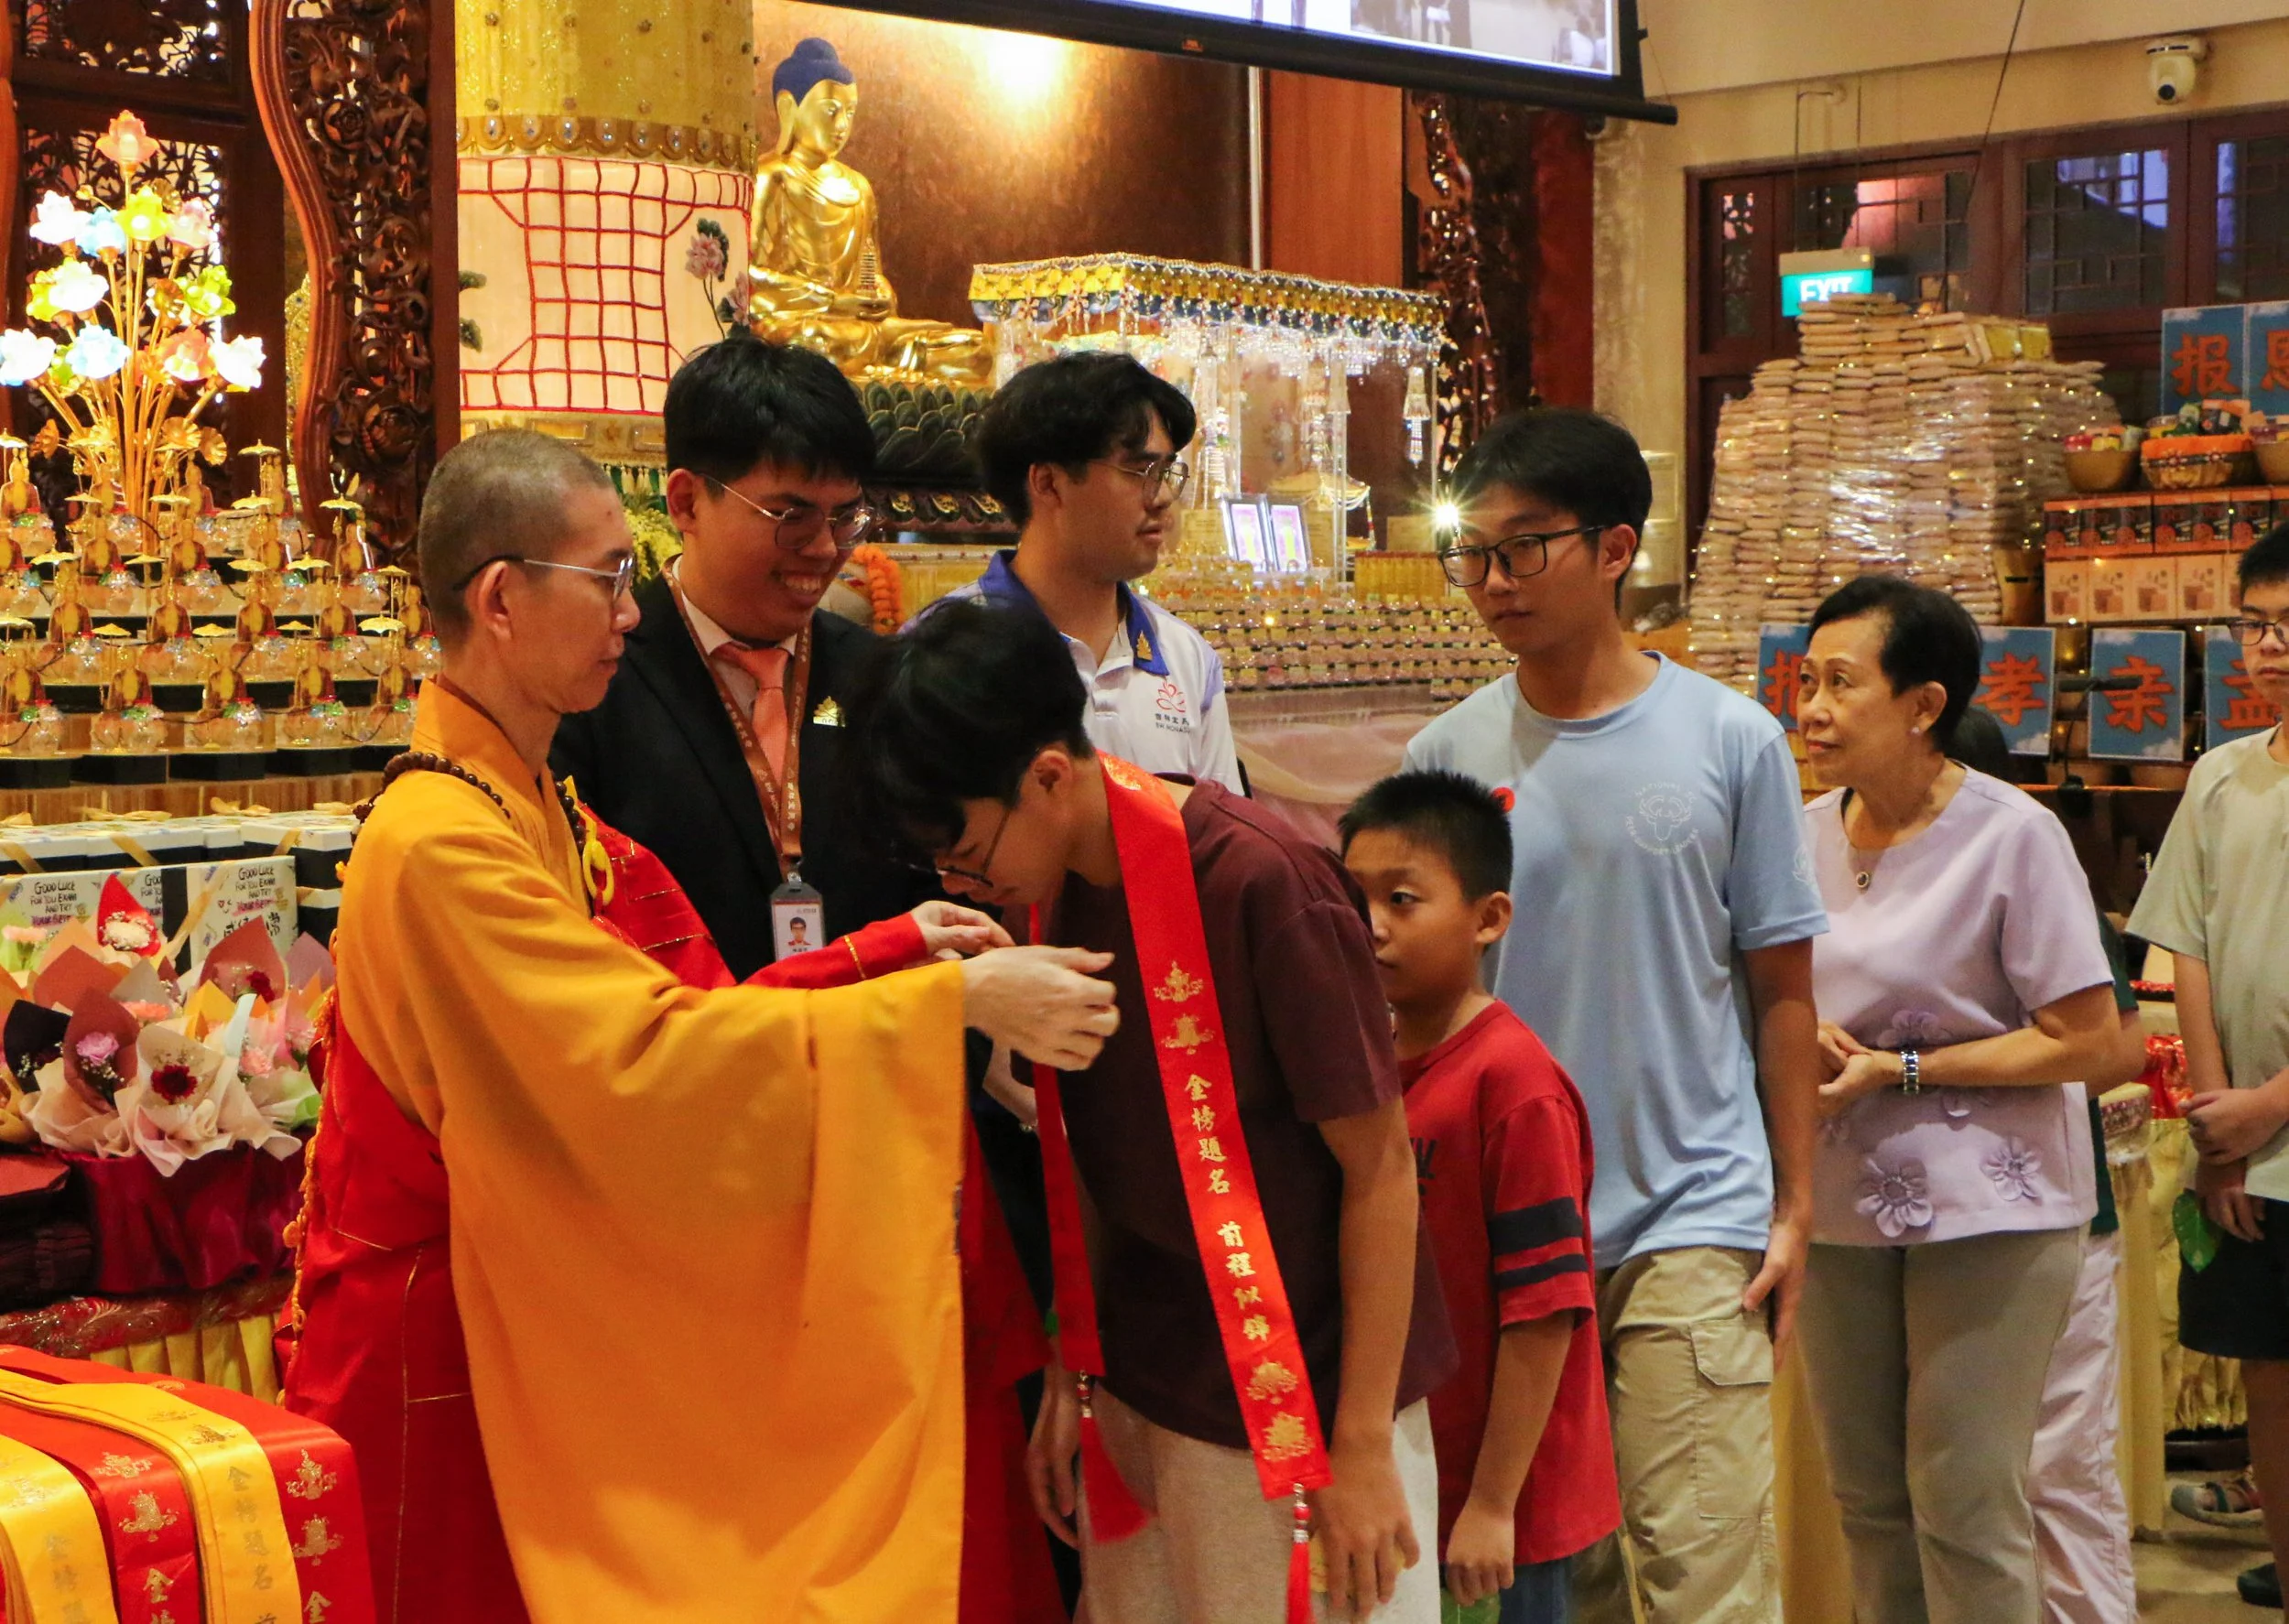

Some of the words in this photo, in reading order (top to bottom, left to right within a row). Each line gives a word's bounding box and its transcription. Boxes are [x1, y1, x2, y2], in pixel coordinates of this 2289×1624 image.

[1800, 276, 1853, 302] EXIT
[2171, 332, 2241, 396] 报
[1973, 652, 2045, 726] 孝
[2103, 655, 2175, 732] 亲
[145, 873, 162, 886] GOO
